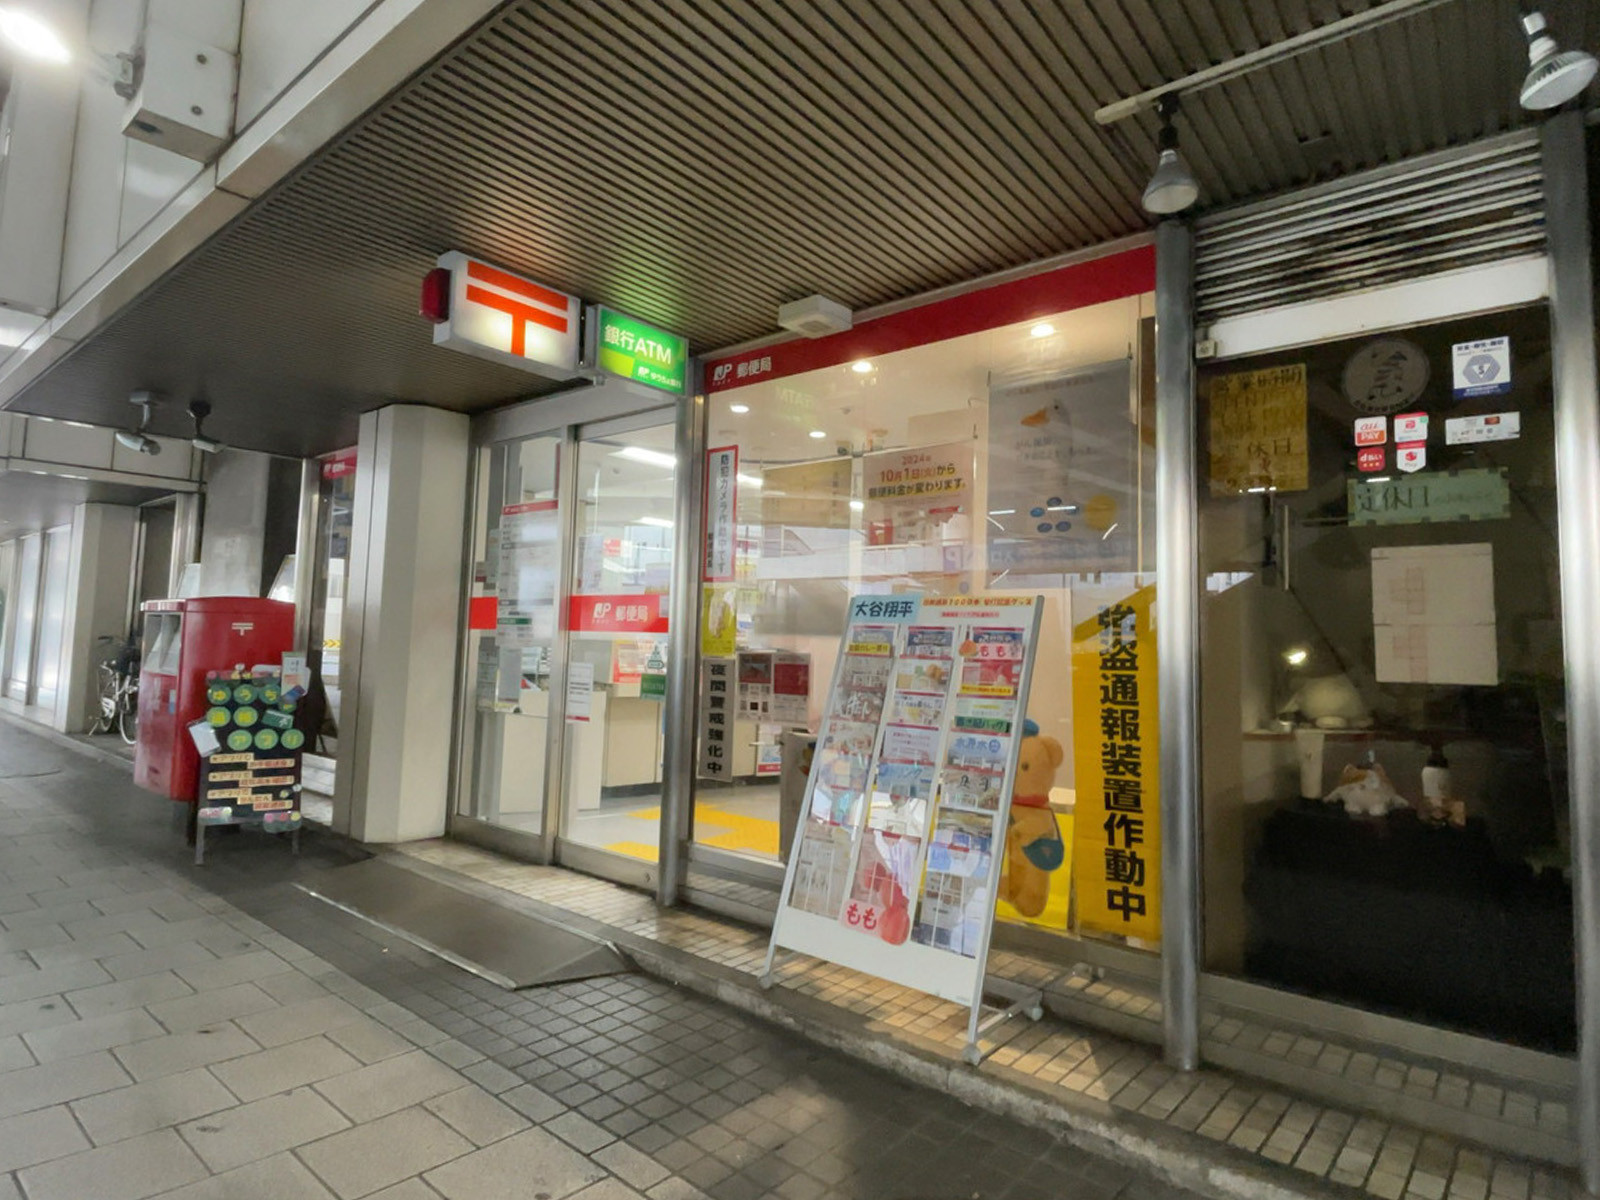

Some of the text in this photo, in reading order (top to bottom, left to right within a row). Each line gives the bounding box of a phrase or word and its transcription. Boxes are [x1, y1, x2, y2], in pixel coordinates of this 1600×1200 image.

[604, 324, 673, 365] 銀行ATM
[713, 357, 772, 381] JP 郵便局
[901, 455, 931, 466] 2024年
[868, 478, 966, 499] 郵便料金が変わります。
[615, 605, 649, 622] 郵便局
[855, 601, 914, 618] 大谷翔平
[706, 664, 727, 774] 夜間警戒強化中
[846, 903, 877, 930] もも
